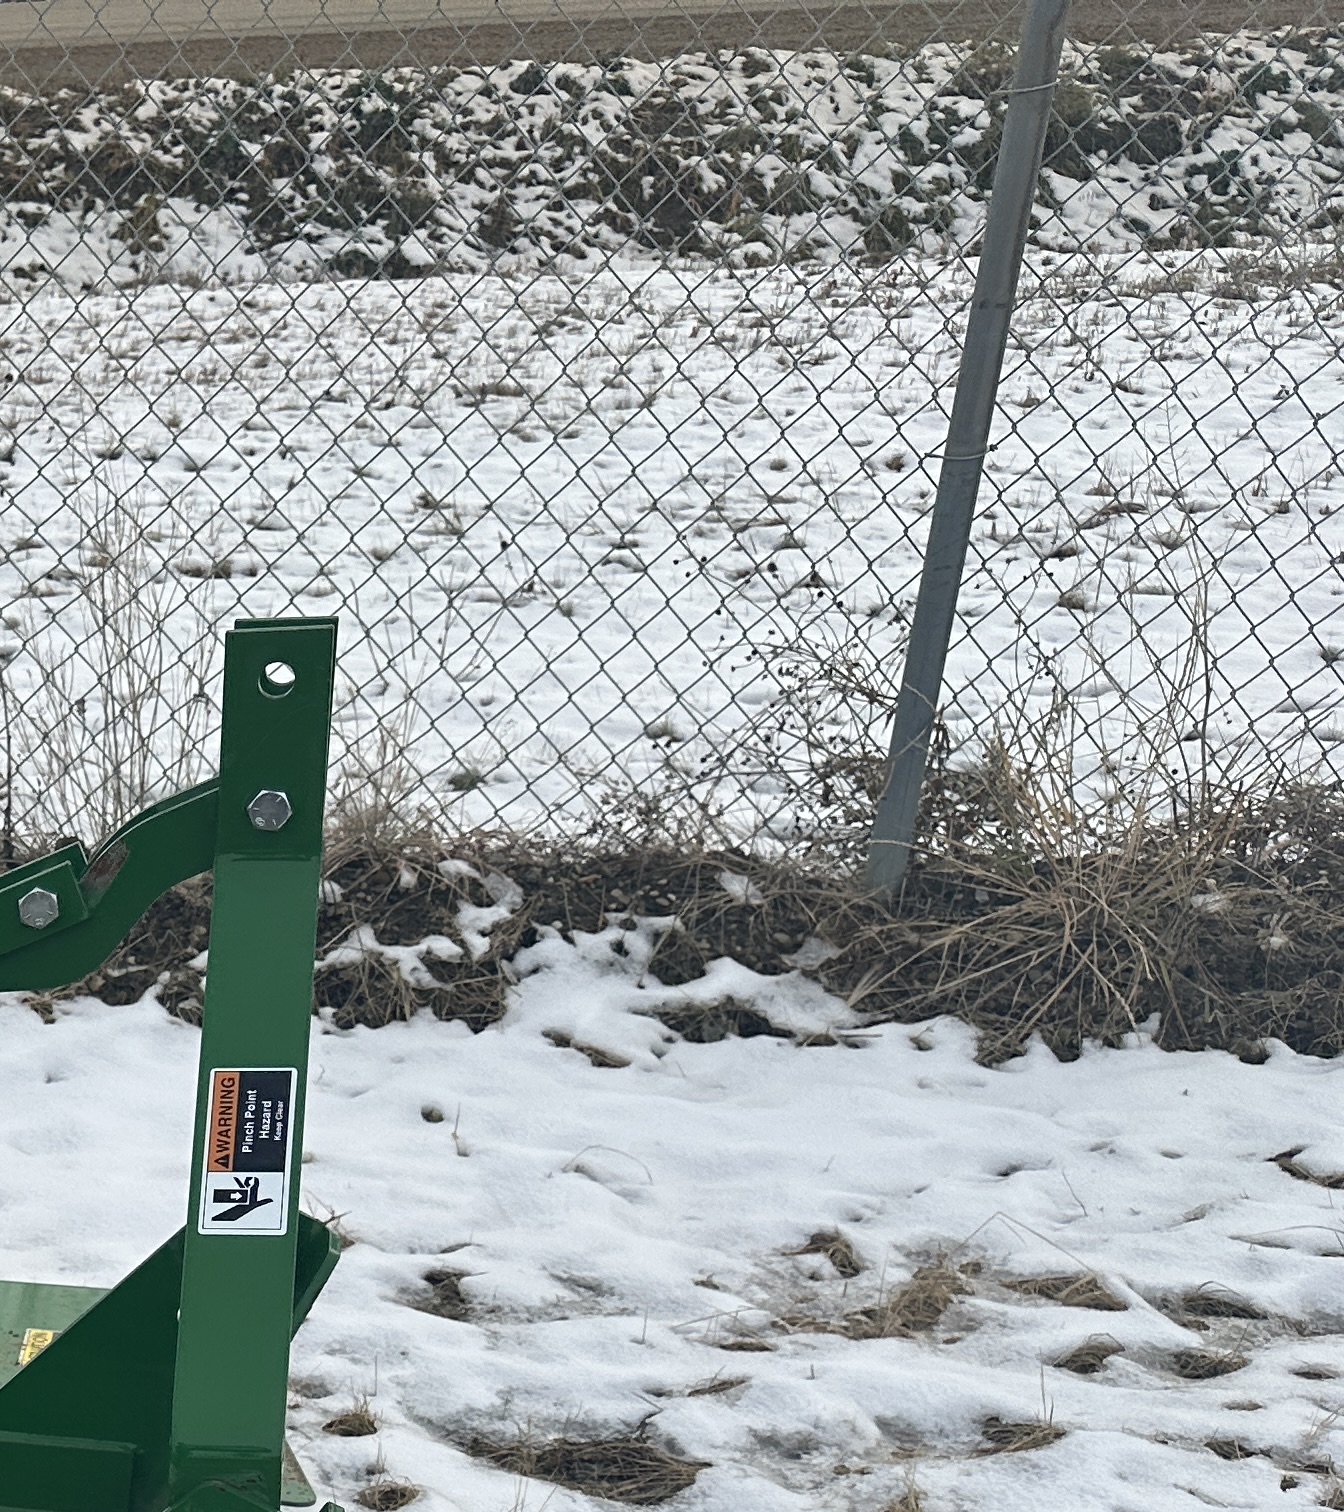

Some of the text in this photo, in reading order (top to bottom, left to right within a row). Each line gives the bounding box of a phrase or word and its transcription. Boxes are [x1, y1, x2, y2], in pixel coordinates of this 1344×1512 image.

[216, 1077, 236, 1153] WARNING
[241, 1089, 258, 1153] Pinch Point
[259, 1100, 272, 1139] Hazard
[273, 1101, 284, 1141] Keep Clear
